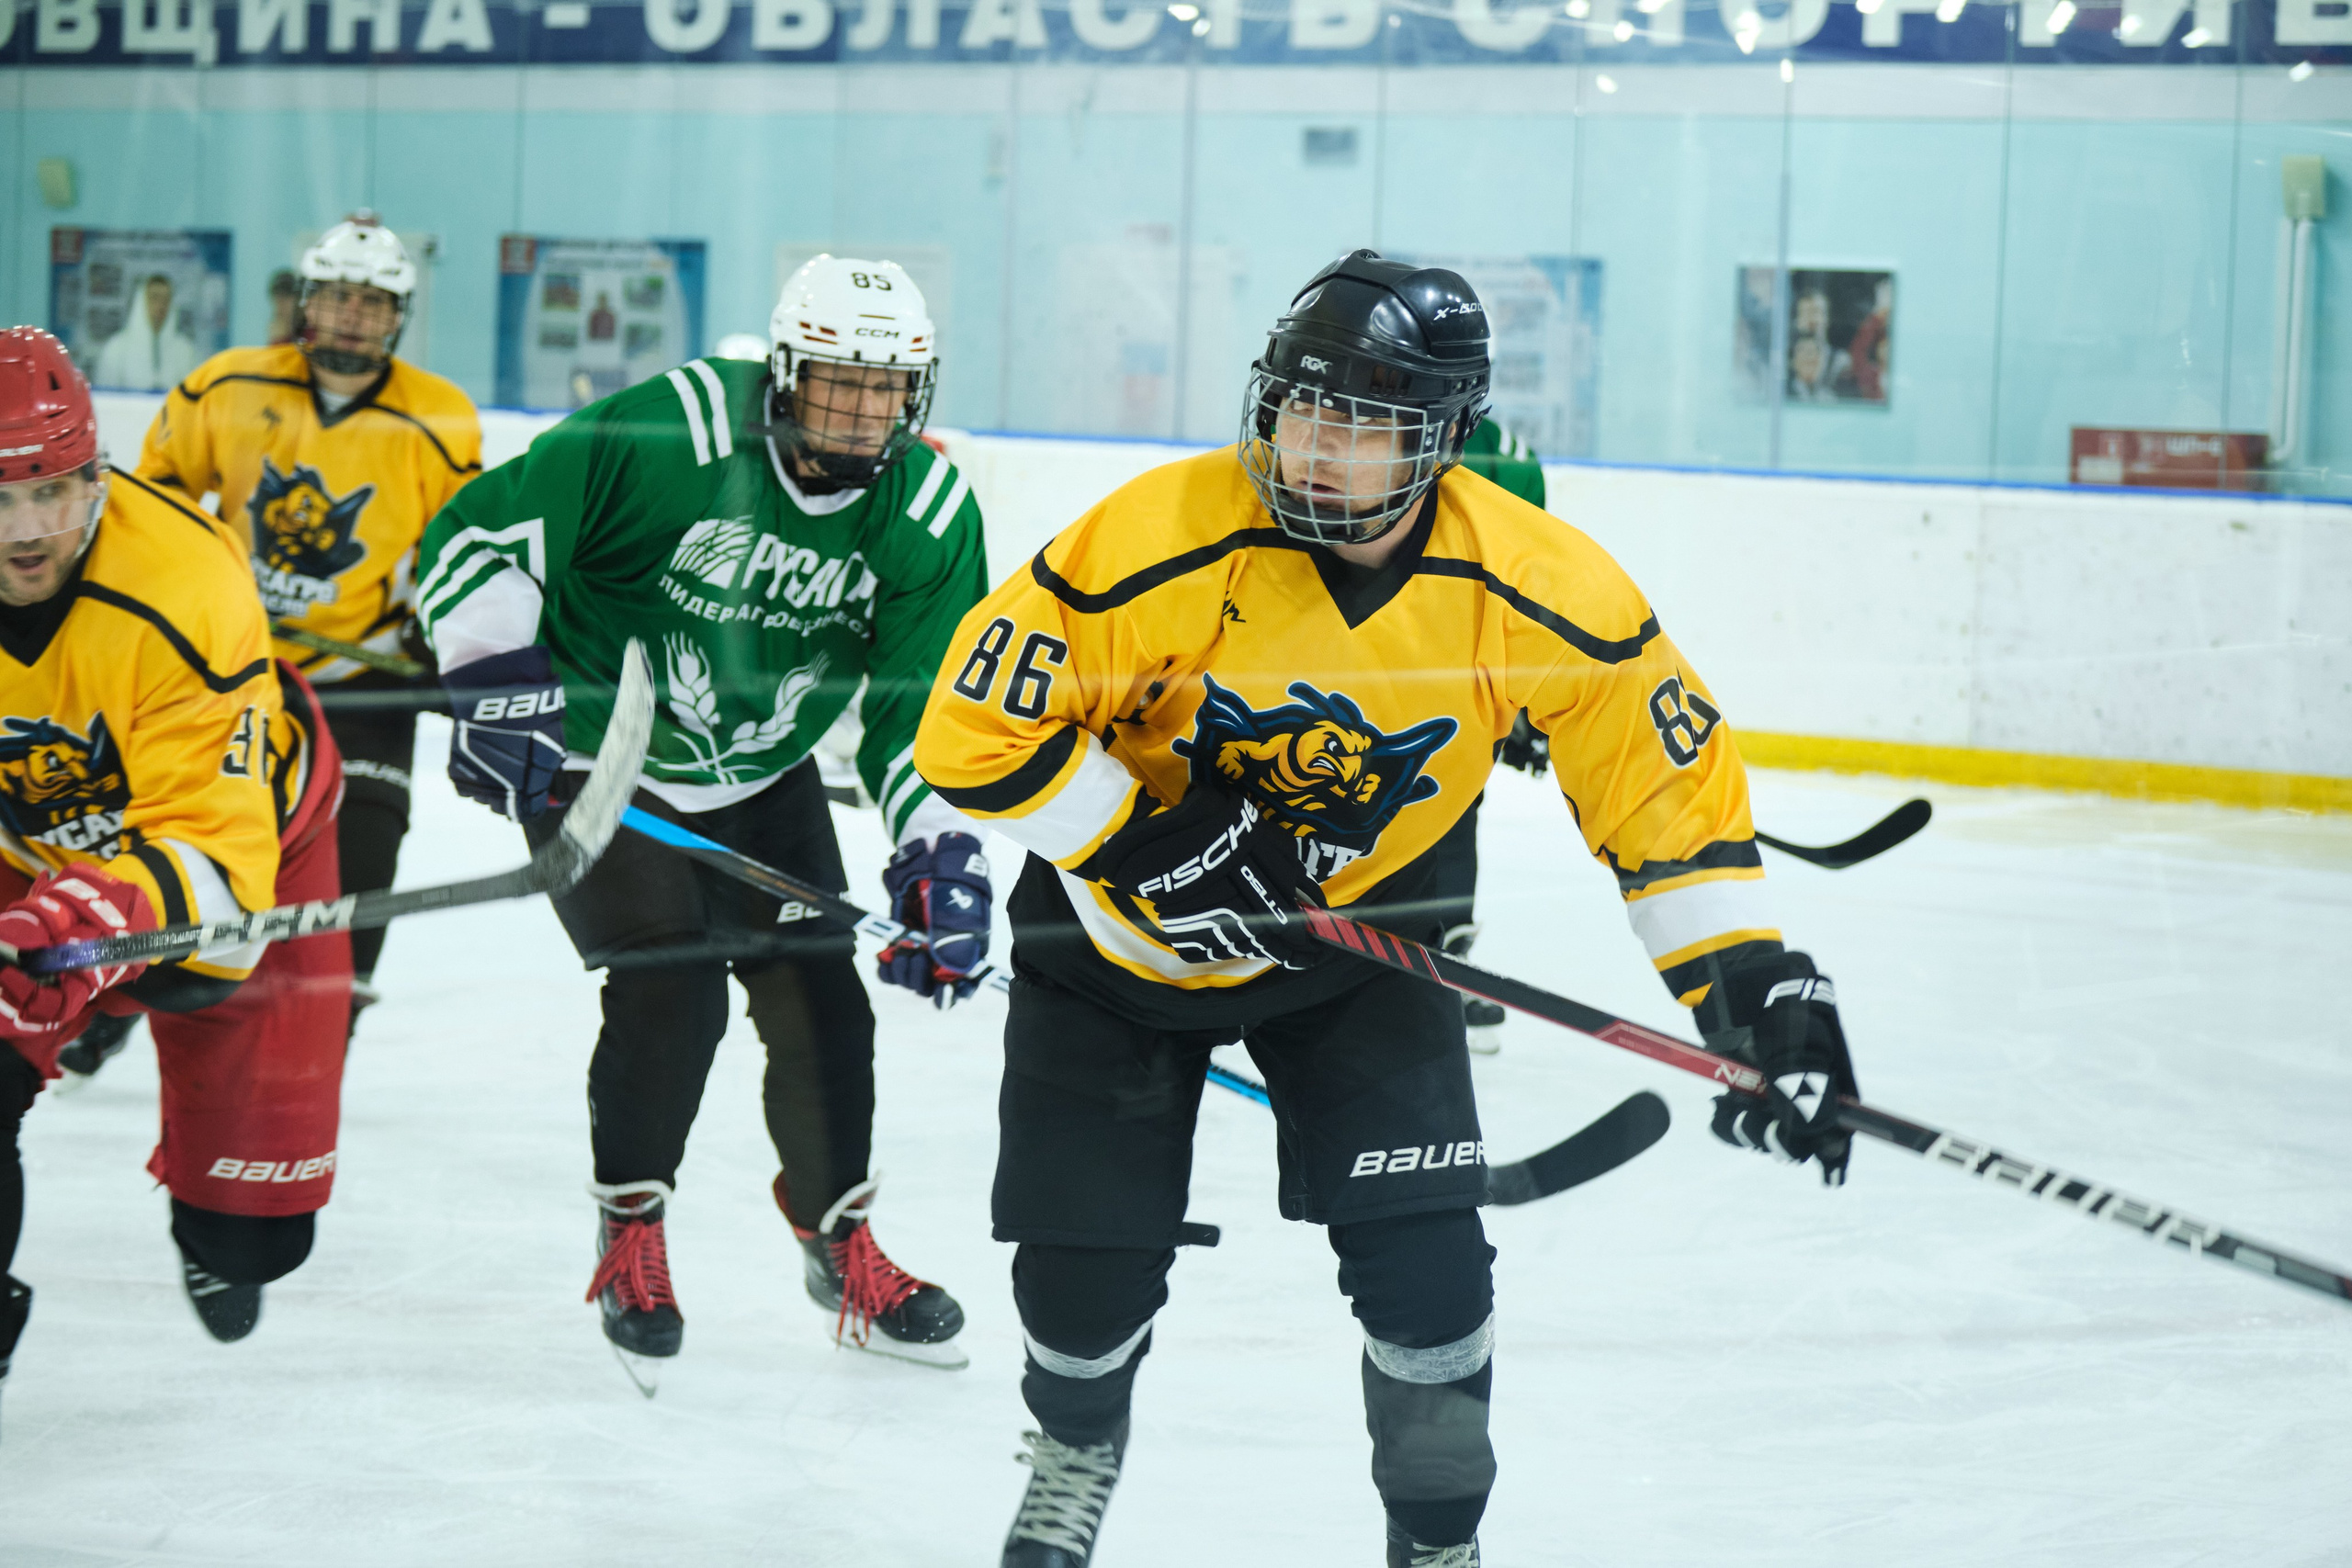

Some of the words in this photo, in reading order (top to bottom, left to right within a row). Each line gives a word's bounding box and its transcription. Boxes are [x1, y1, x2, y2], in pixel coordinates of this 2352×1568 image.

[0, 0, 494, 66] ВЩИНА
[851, 272, 892, 291] 85
[855, 328, 899, 339] CCM
[953, 615, 1069, 721] 86
[473, 686, 566, 721] BAU
